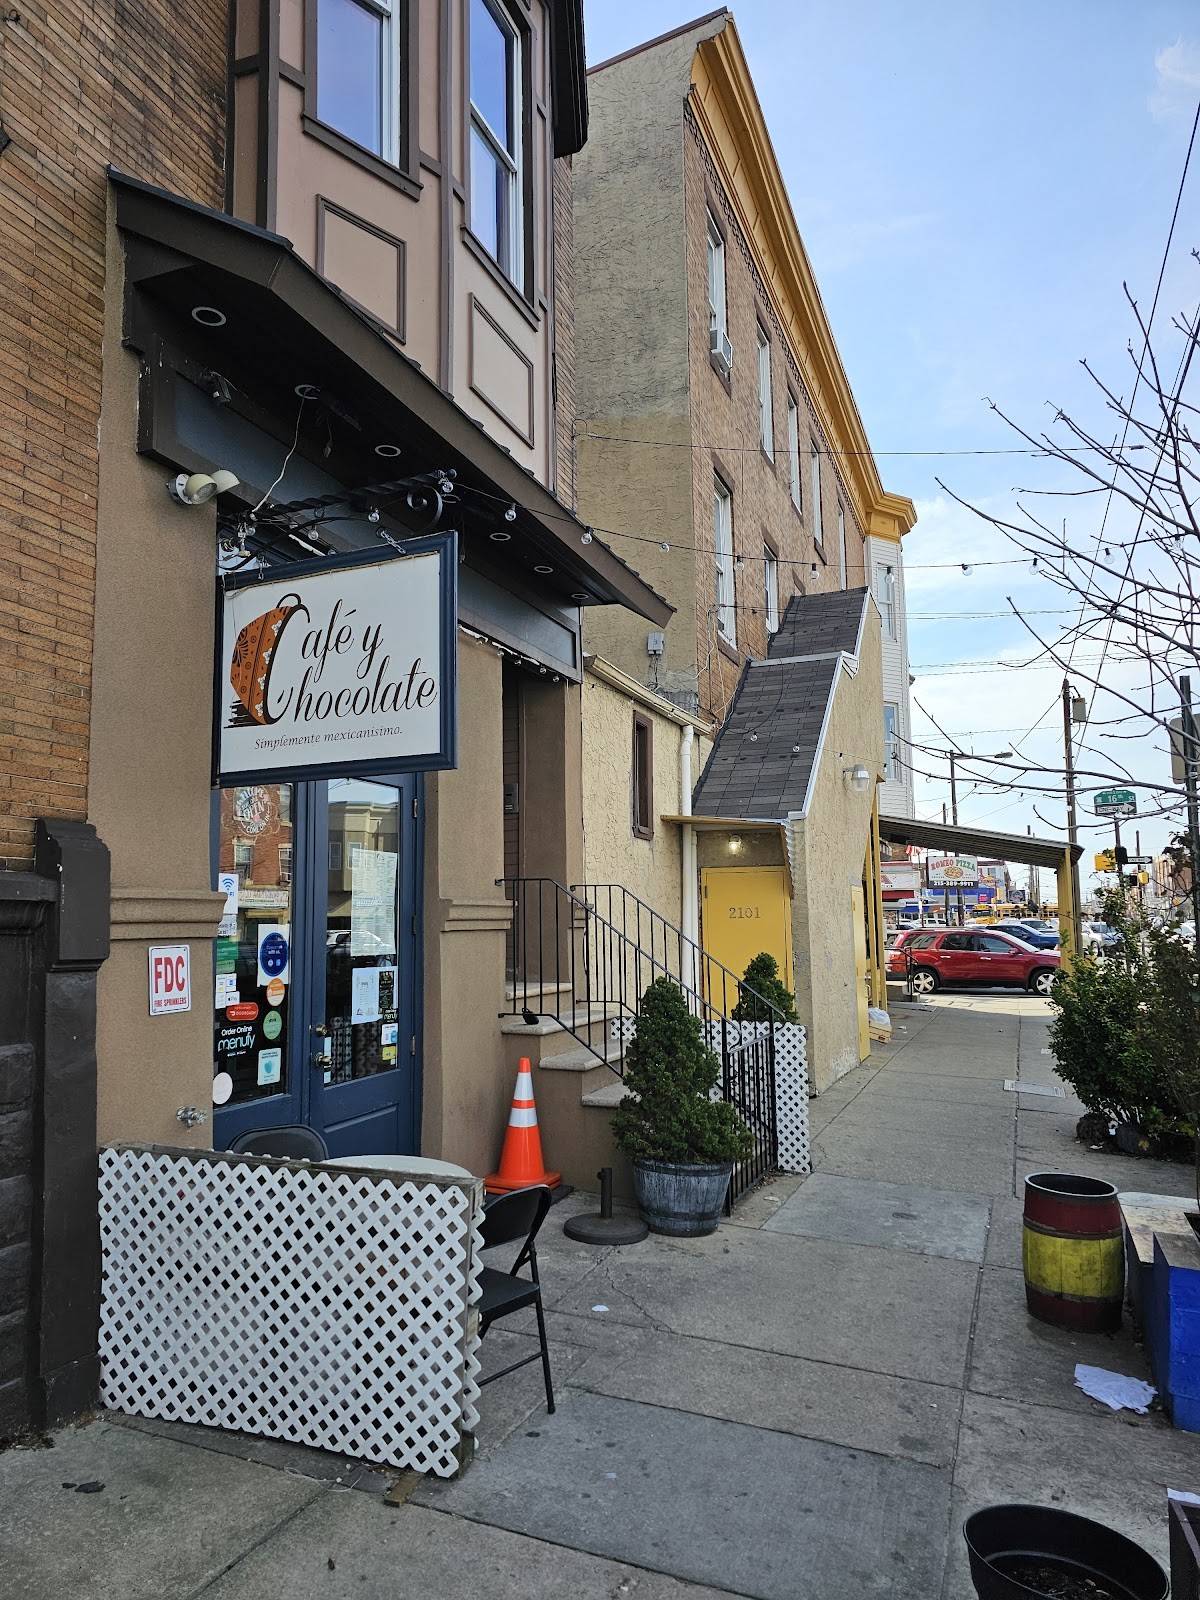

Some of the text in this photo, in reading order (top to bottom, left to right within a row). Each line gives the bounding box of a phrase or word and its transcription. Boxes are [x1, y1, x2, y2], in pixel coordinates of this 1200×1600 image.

[265, 598, 384, 684] Café y
[265, 655, 438, 724] Chocolate
[254, 733, 321, 751] Simplemente
[931, 859, 976, 872] ROMEO PIZZA
[729, 907, 761, 919] 2101
[154, 956, 185, 993] FDC
[154, 996, 187, 1007] FIRE SPRINKLERS
[221, 1025, 253, 1037] Order Online
[217, 1032, 255, 1052] menufy
